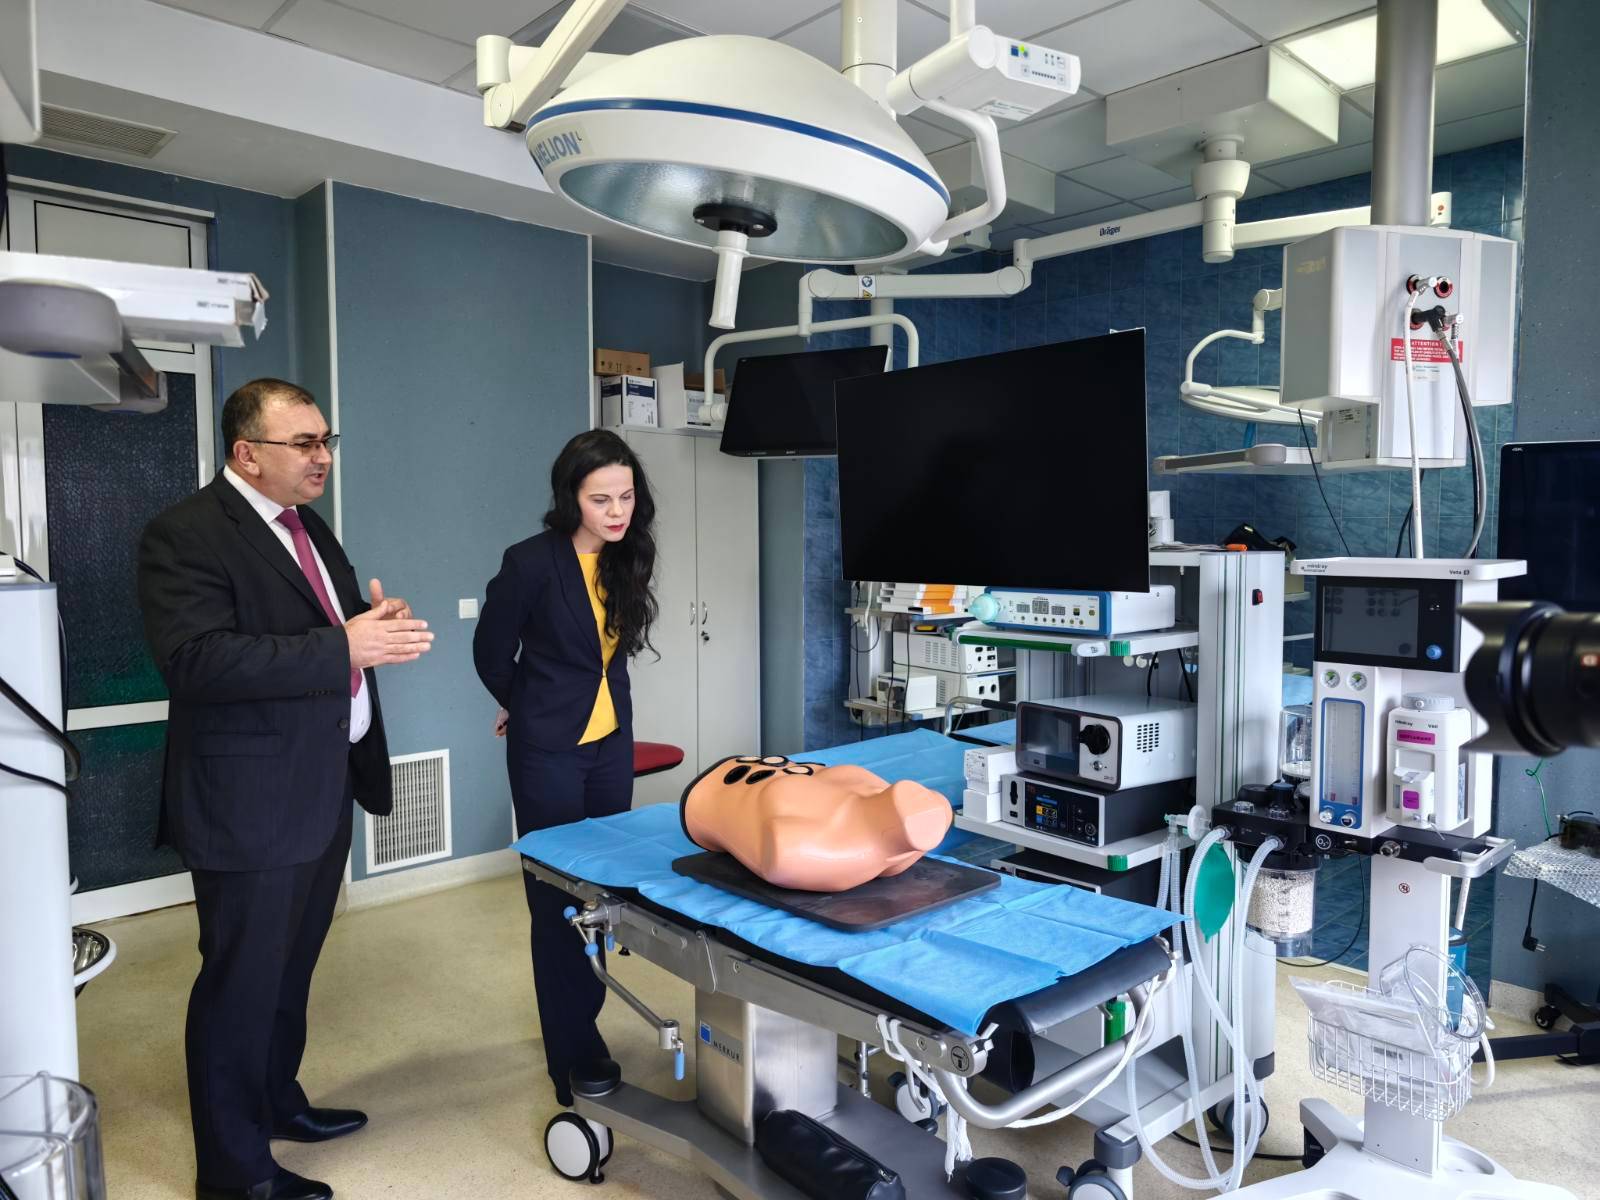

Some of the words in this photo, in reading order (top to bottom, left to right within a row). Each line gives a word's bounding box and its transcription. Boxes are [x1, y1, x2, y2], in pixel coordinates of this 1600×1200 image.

[534, 131, 581, 167] HELION
[1099, 226, 1121, 237] Dräger
[713, 1039, 740, 1062] MERKUR
